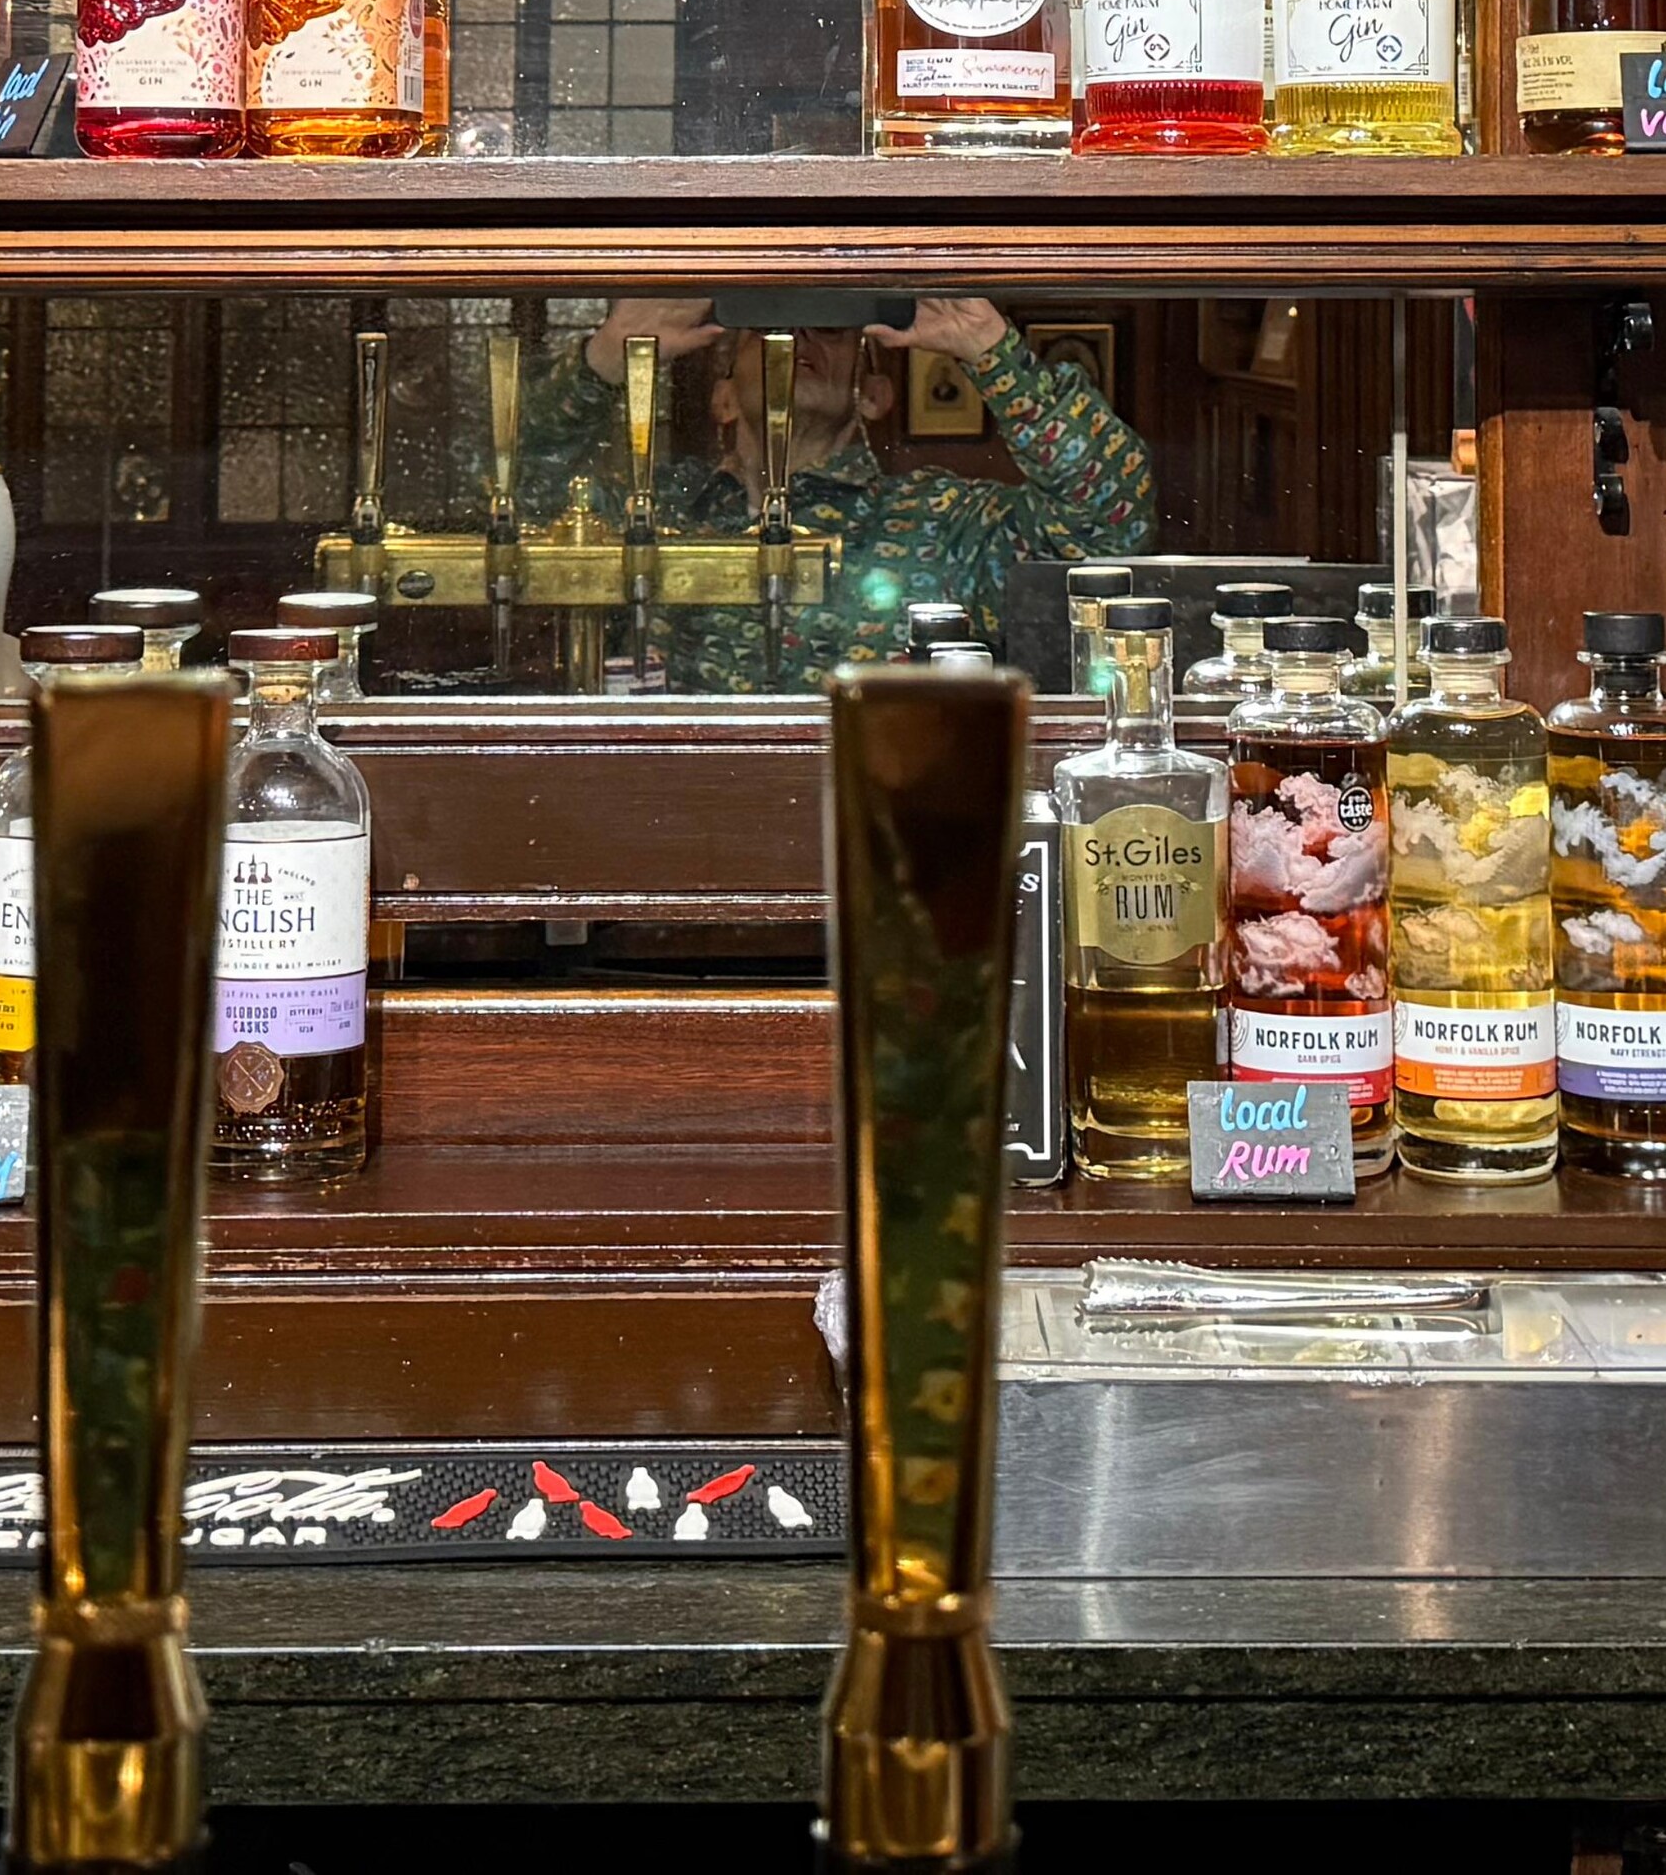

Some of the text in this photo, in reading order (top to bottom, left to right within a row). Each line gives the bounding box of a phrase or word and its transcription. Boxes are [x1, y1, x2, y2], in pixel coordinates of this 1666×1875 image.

[1319, 0, 1352, 10] HOME
[1105, 14, 1149, 62] Gin
[1329, 14, 1383, 63] Gin
[299, 79, 322, 87] GIN
[1340, 804, 1373, 818] taste
[1085, 835, 1202, 867] St.Giles
[234, 889, 273, 905] THE
[1116, 884, 1173, 921] RUM
[1255, 1027, 1378, 1050] NORFOLK RUM
[1415, 1019, 1538, 1042] NORFOLK RUM
[1576, 1021, 1661, 1044] NORFOLK
